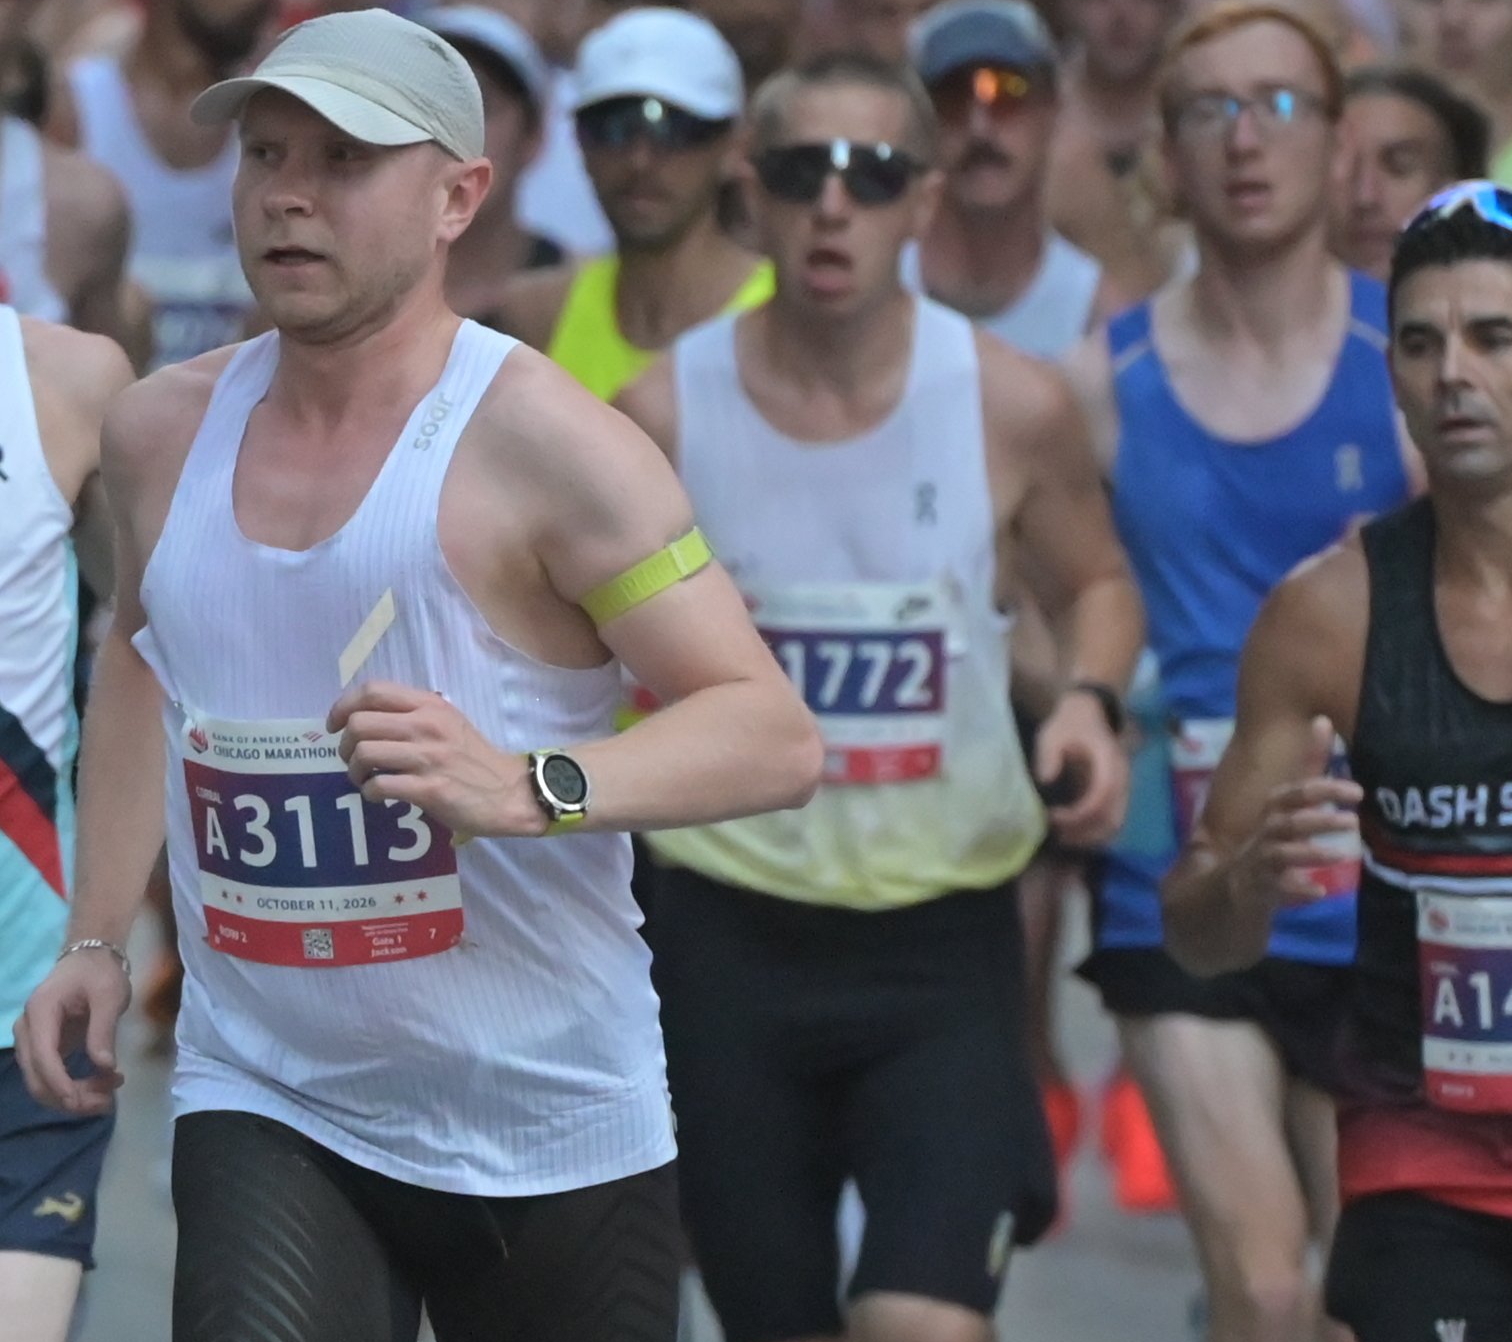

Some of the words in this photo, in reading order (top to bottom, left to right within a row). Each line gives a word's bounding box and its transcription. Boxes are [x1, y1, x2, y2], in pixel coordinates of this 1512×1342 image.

[414, 392, 453, 451] soar
[779, 639, 933, 708] 1772
[253, 735, 300, 744] AMERICA
[213, 745, 261, 760] CHICAGO
[265, 747, 337, 760] MARATHON
[206, 792, 433, 869] A3113
[257, 898, 314, 911] OCTOBER
[344, 897, 377, 910] 2026
[428, 927, 436, 940] 7
